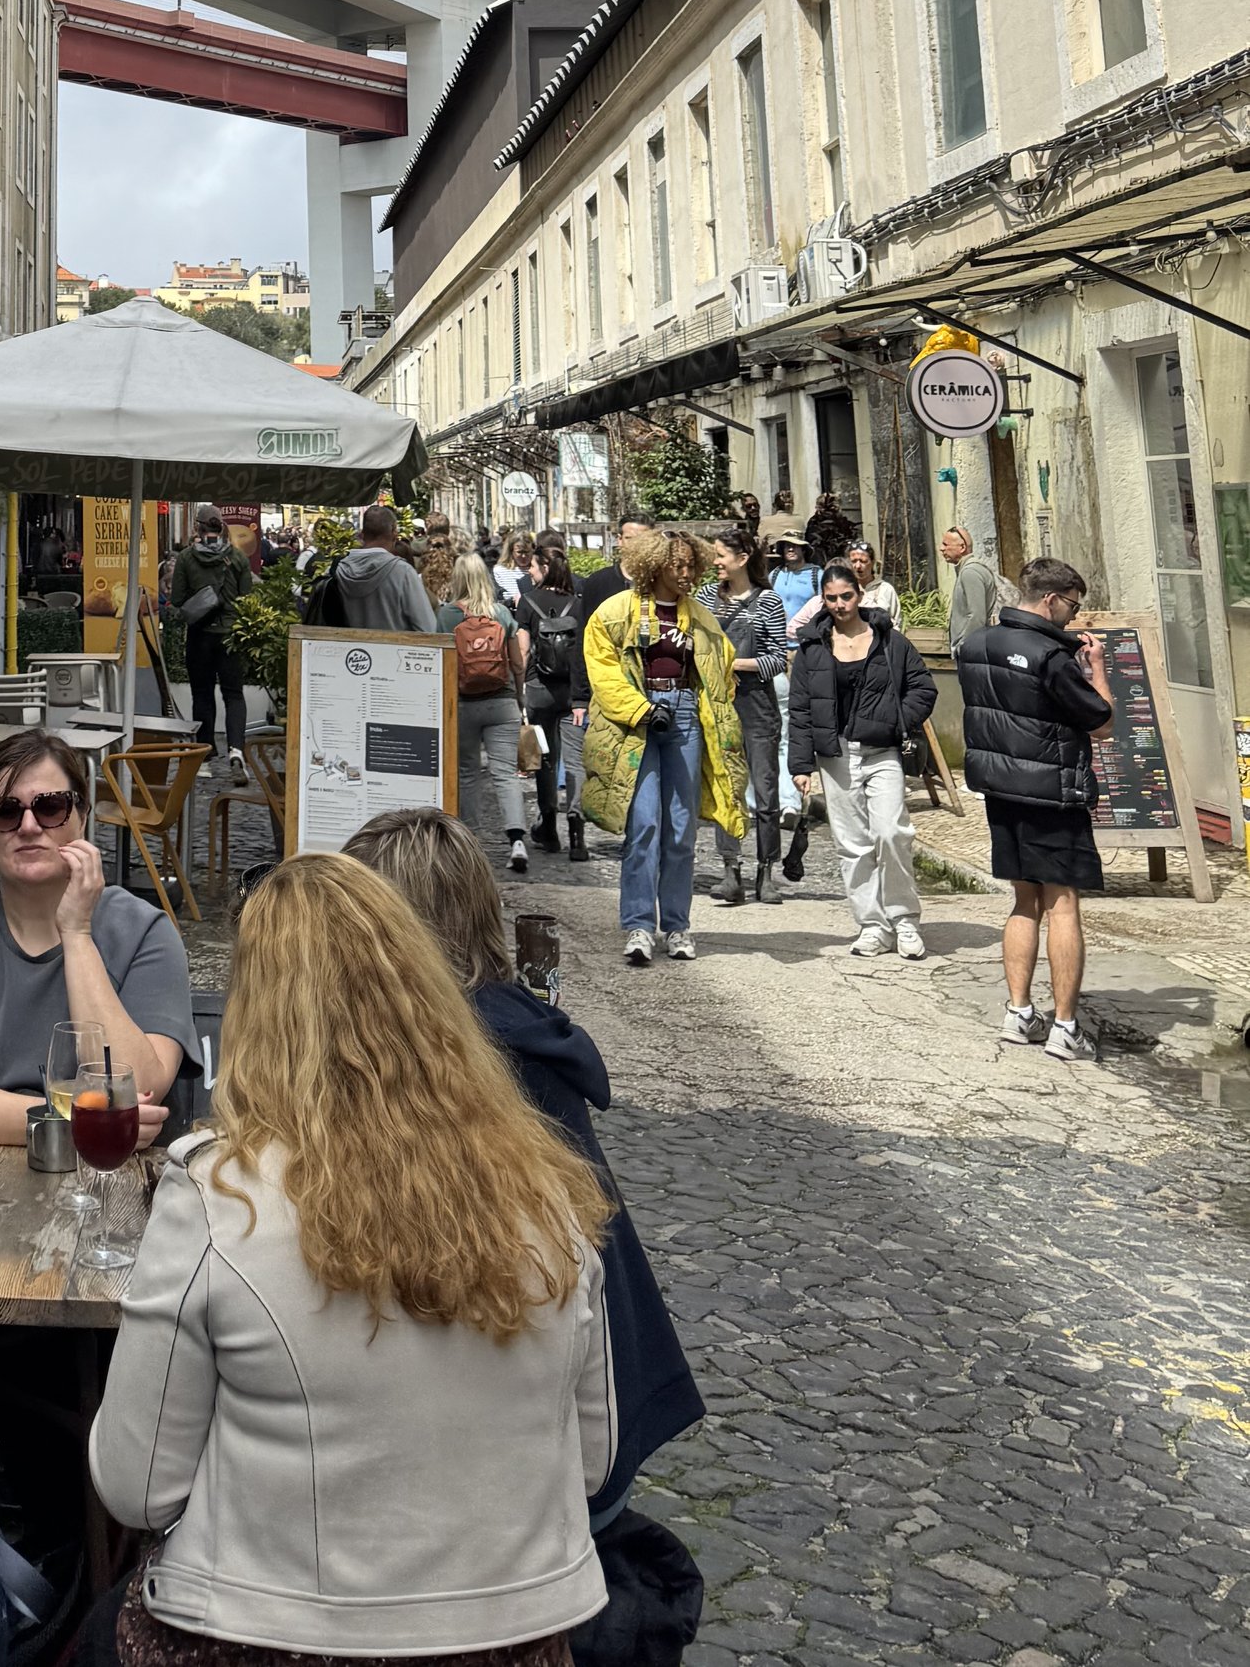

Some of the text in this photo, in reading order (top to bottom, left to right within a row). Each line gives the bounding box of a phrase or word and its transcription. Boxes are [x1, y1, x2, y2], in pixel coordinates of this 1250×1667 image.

[923, 381, 992, 396] CERÂMICA
[257, 428, 342, 458] SUMOL
[94, 505, 119, 521] CAKE
[95, 556, 120, 568] CHEESE
